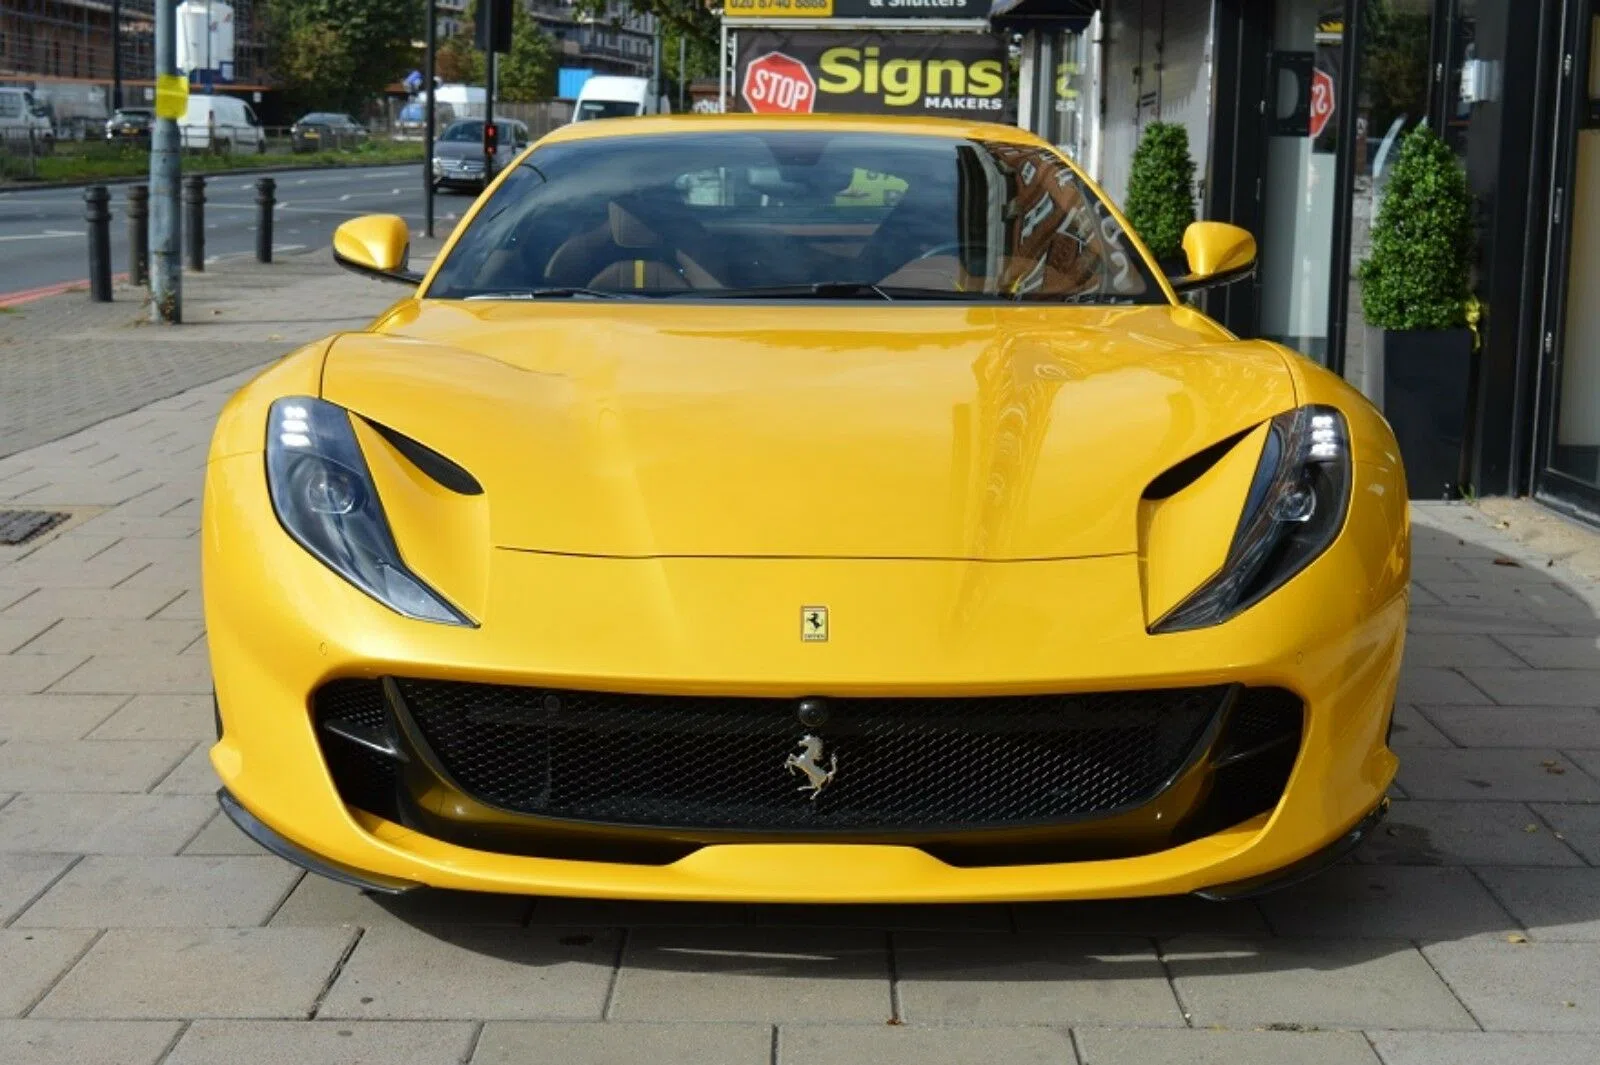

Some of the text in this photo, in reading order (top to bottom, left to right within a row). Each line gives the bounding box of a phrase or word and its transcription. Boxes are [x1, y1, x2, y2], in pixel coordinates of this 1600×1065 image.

[751, 68, 809, 113] STOP
[819, 46, 1004, 106] Signs
[924, 96, 1003, 110] MAKERS
